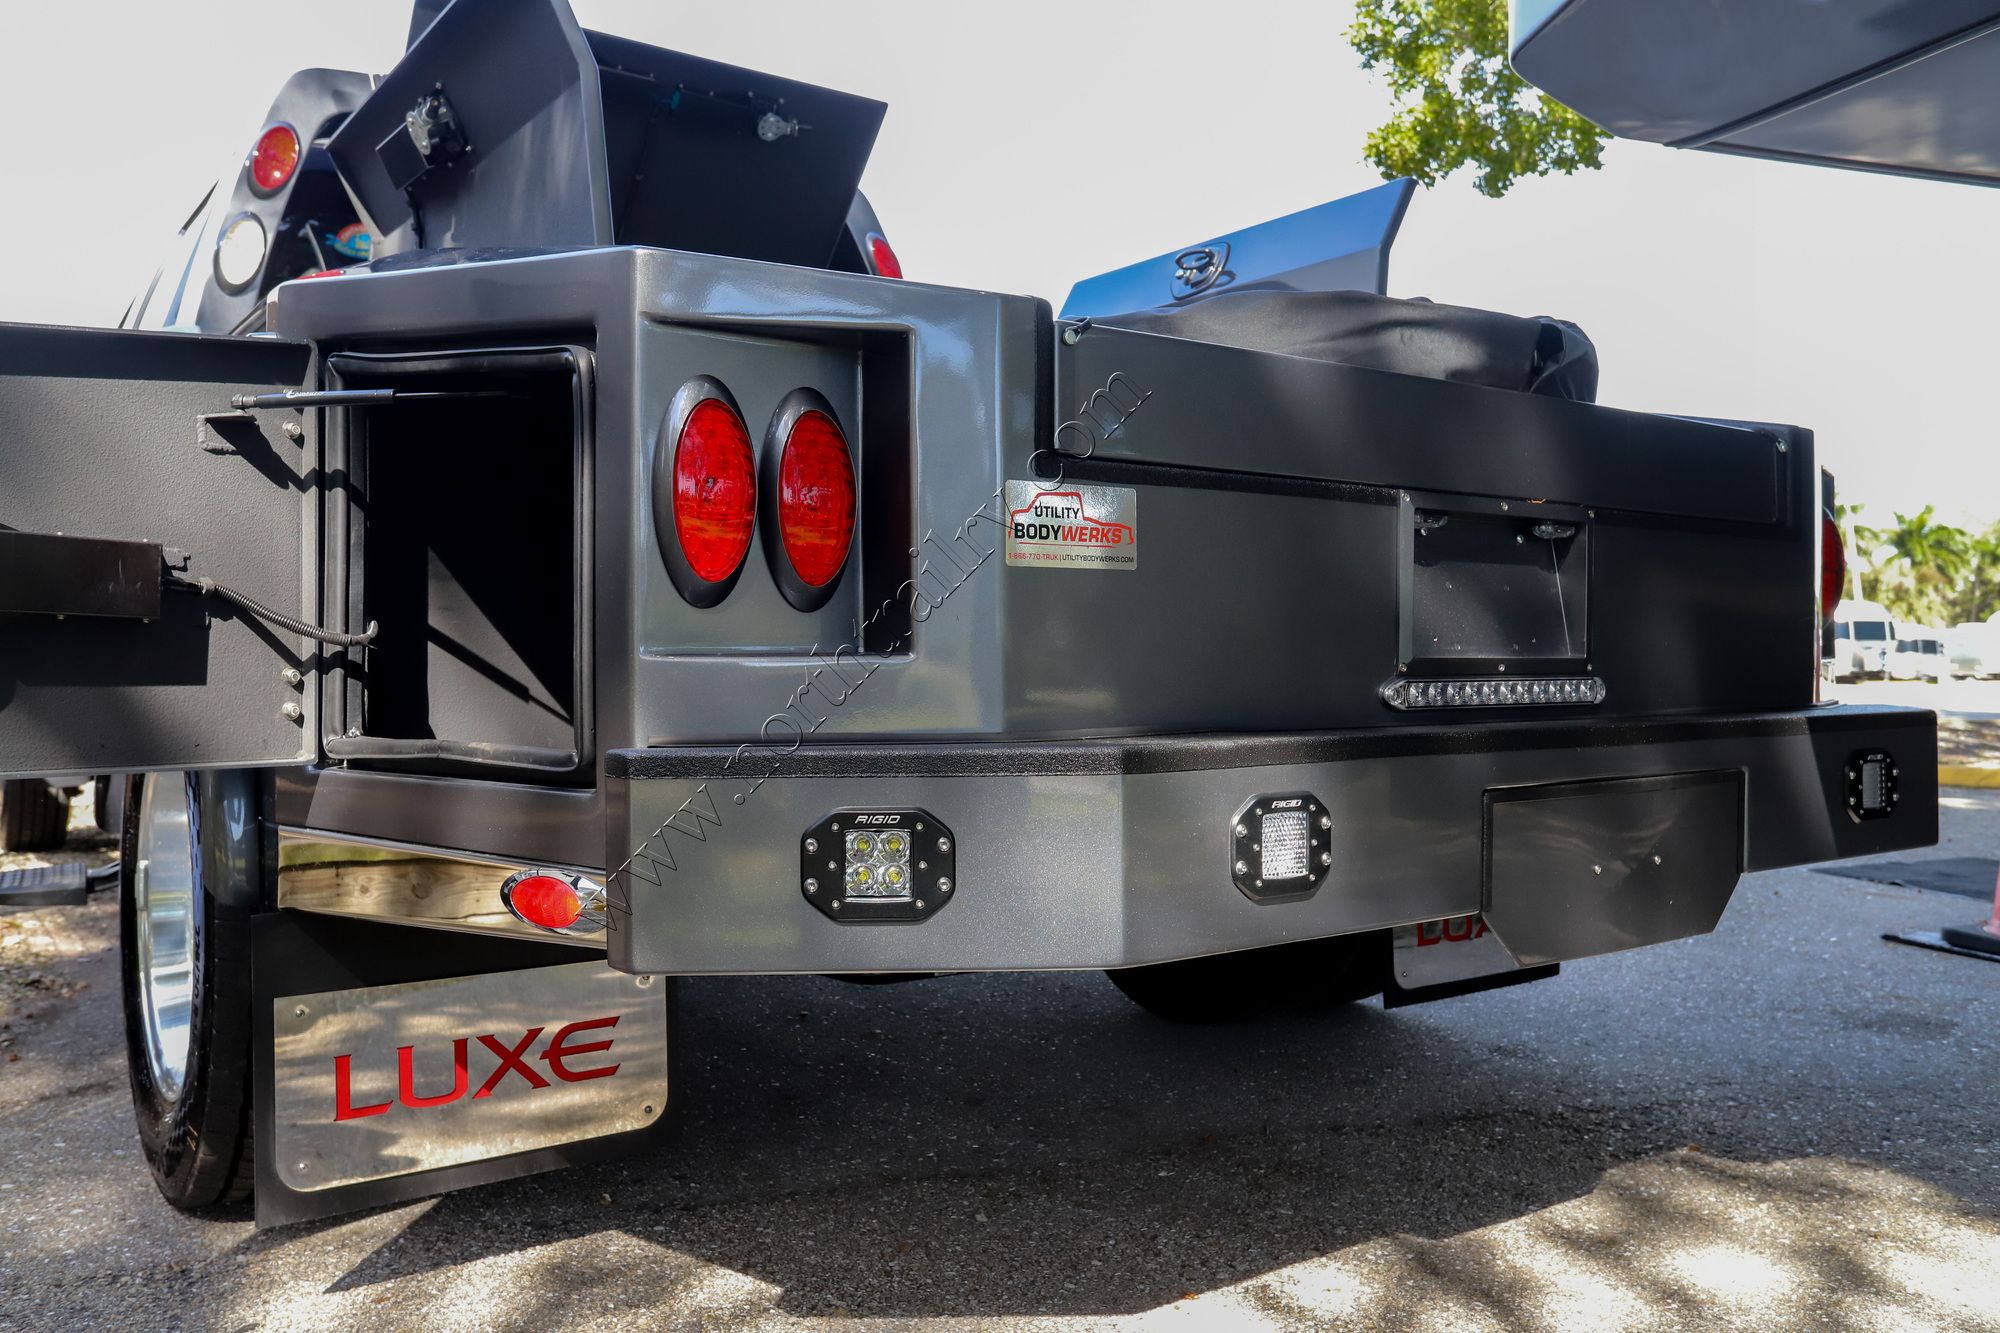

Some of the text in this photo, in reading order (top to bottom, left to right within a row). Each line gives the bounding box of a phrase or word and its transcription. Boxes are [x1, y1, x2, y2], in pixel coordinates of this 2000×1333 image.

[1034, 505, 1081, 519] UTILITY
[1014, 523, 1123, 544] BODYWERKS
[1271, 799, 1302, 809] RIGID
[855, 815, 900, 824] RIGID
[1417, 915, 1489, 947] LU
[333, 1015, 621, 1122] LUXE
